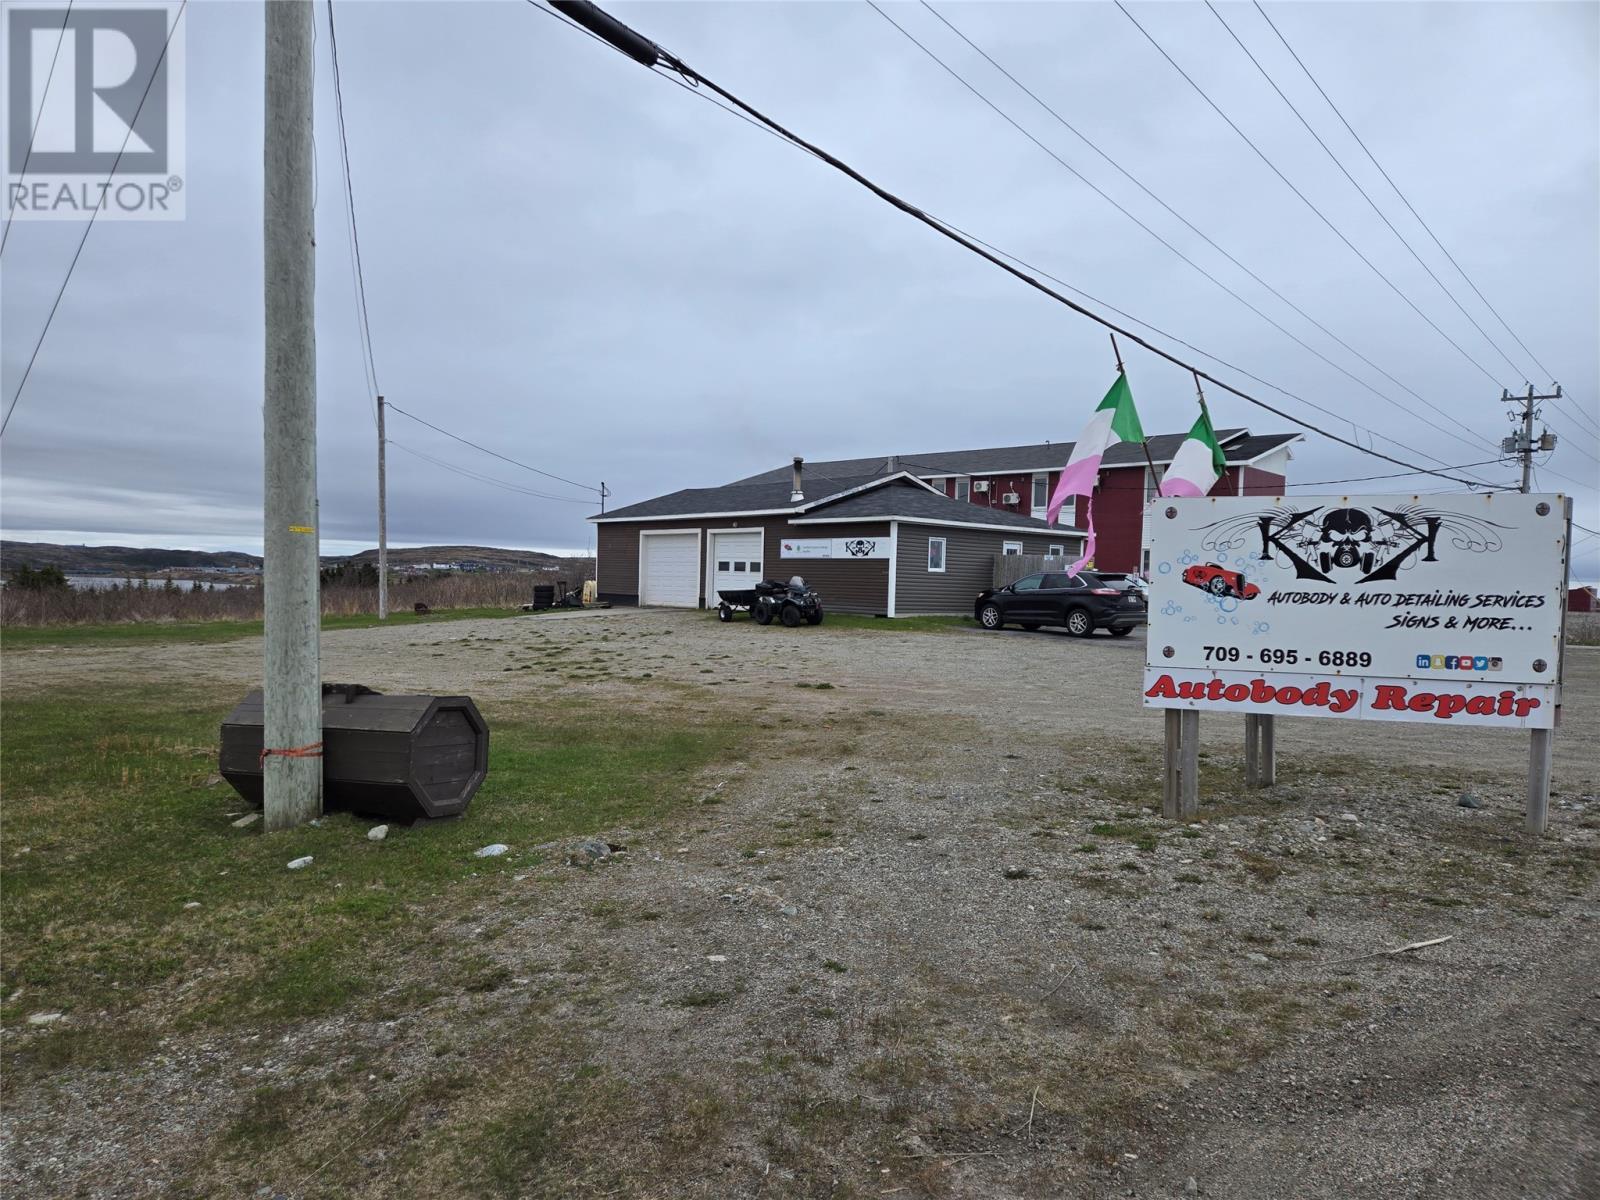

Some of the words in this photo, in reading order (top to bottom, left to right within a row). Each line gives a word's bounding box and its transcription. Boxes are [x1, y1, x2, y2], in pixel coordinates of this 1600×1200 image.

[1266, 590, 1339, 606] AUTOBODY
[1339, 592, 1352, 606] &
[1354, 591, 1392, 608] AUTO
[1444, 615, 1459, 630] &
[1462, 615, 1533, 633] MORE...
[1203, 645, 1240, 663] 709
[1259, 648, 1298, 665] 695
[1318, 650, 1372, 668] 6889
[1145, 674, 1359, 713] Autobody
[1371, 684, 1541, 719] Repair
